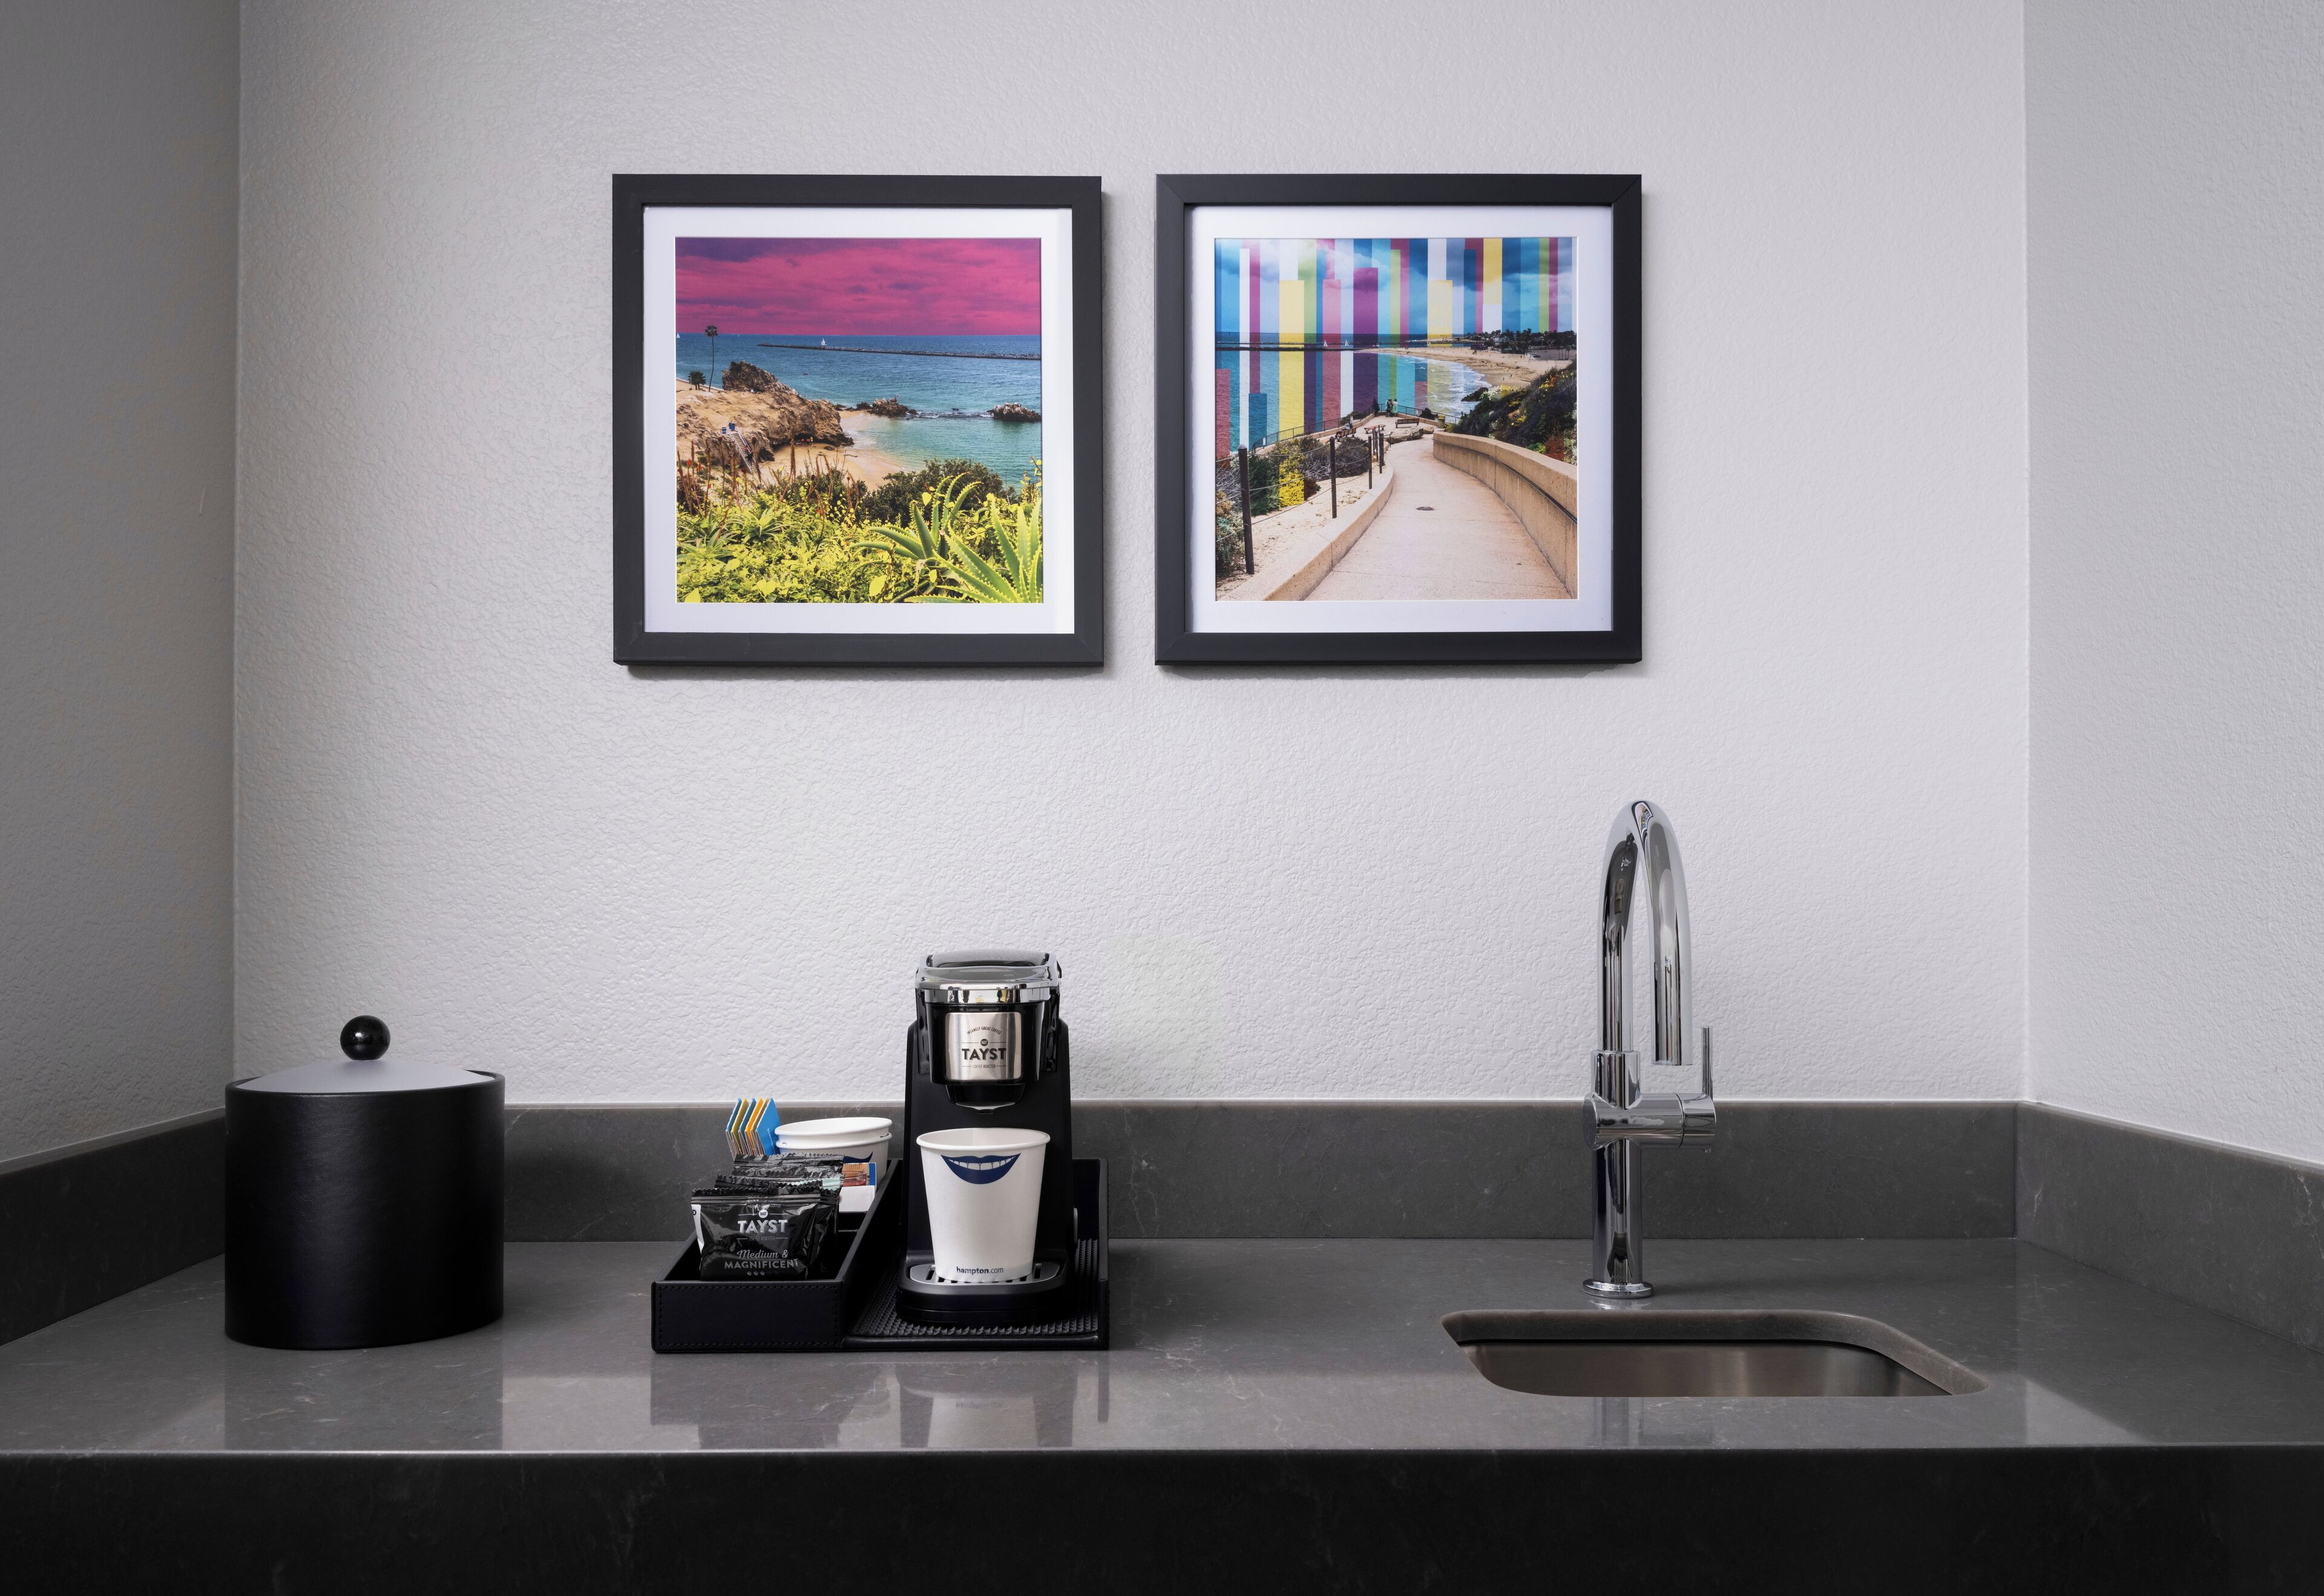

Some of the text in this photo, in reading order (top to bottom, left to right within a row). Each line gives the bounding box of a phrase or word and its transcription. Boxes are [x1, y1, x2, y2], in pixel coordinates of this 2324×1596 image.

[967, 1026, 980, 1035] INSANELY
[962, 1048, 1006, 1060] TAYST
[738, 1220, 788, 1233] TAYST
[737, 1249, 788, 1259] Medium &
[724, 1258, 799, 1269] MAGNIFICENT
[956, 1266, 1004, 1276] hampton.com
